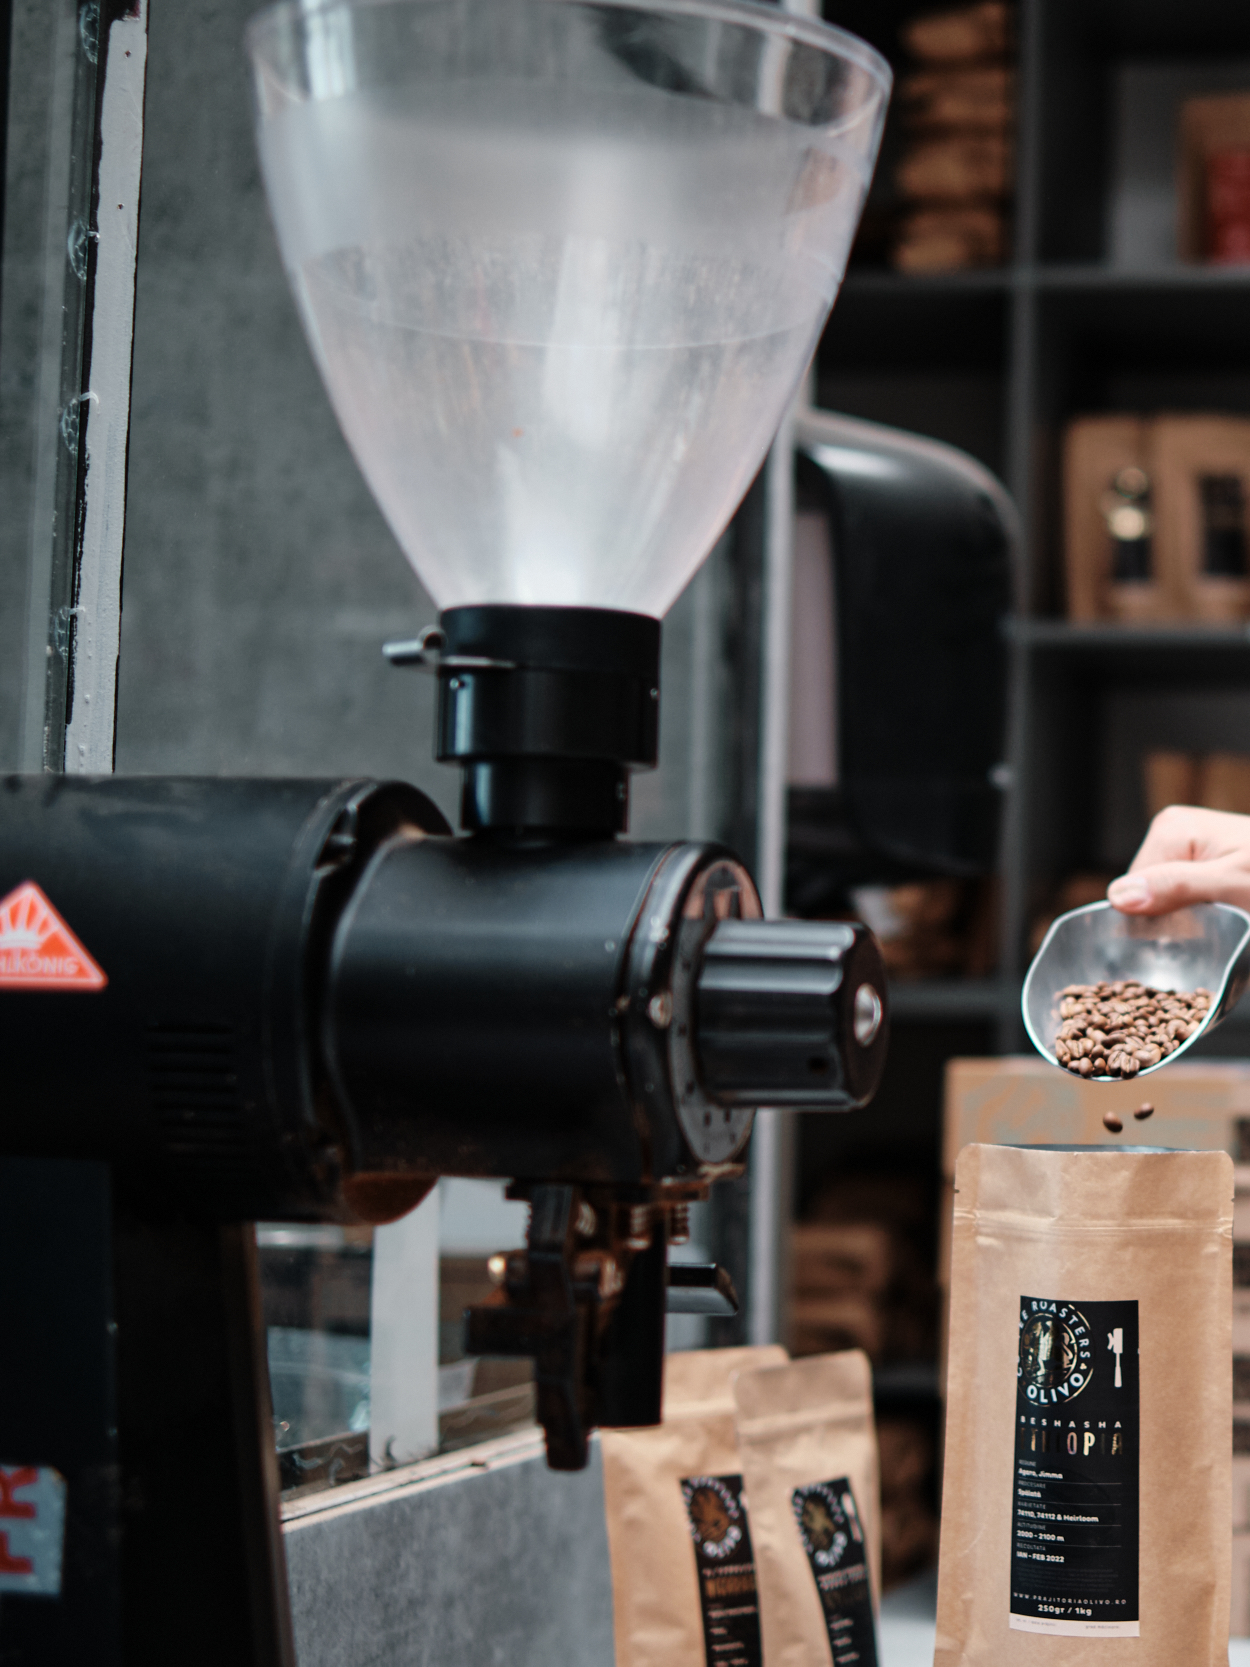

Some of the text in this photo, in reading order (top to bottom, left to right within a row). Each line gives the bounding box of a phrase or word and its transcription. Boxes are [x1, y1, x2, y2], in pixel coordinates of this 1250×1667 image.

[1031, 1301, 1090, 1358] ROASTERS
[1026, 1373, 1084, 1403] OLIVO
[1020, 1415, 1122, 1429] BESHASHA
[1036, 1511, 1055, 1520] 74112
[1063, 1514, 1099, 1523] Heirloom
[1038, 1532, 1056, 1541] 2100
[1032, 1552, 1046, 1561] FEB
[1046, 1554, 1065, 1563] 2022
[1037, 1604, 1065, 1615] 250gr
[1074, 1607, 1093, 1617] 1kg
